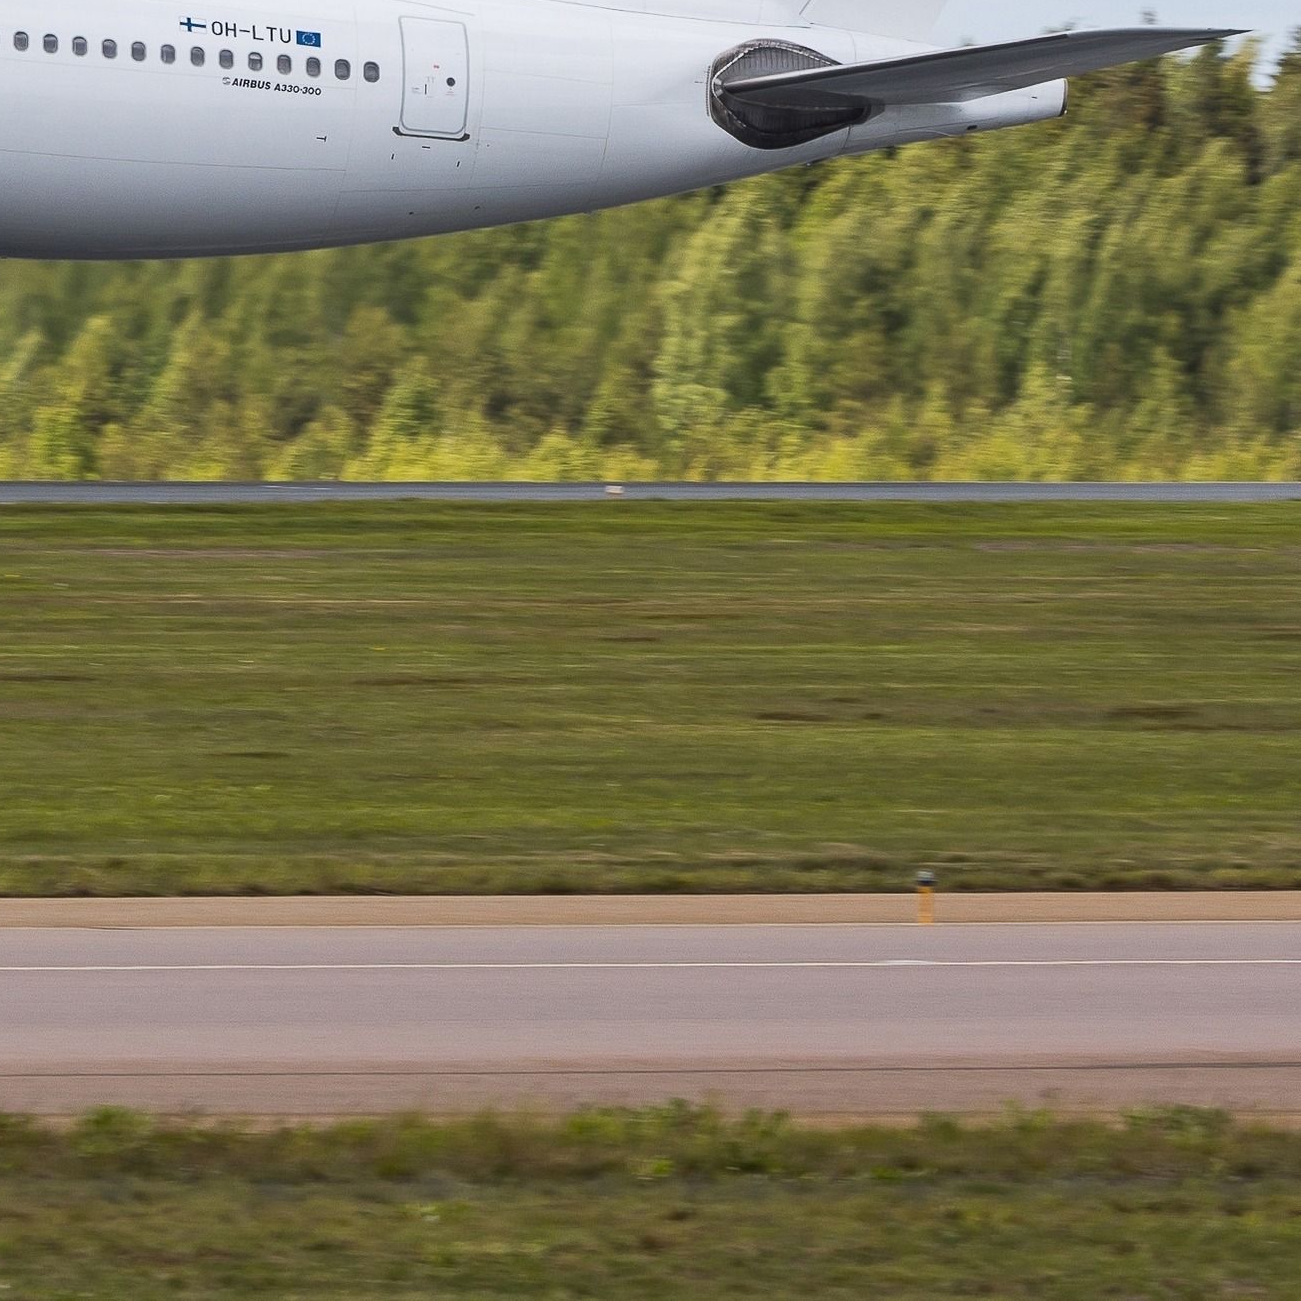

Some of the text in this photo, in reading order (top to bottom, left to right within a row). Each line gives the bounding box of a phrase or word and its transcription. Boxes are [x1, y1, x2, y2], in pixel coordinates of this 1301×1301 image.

[211, 21, 292, 44] OH-LTU
[231, 78, 322, 96] AIRBUS A330-300
